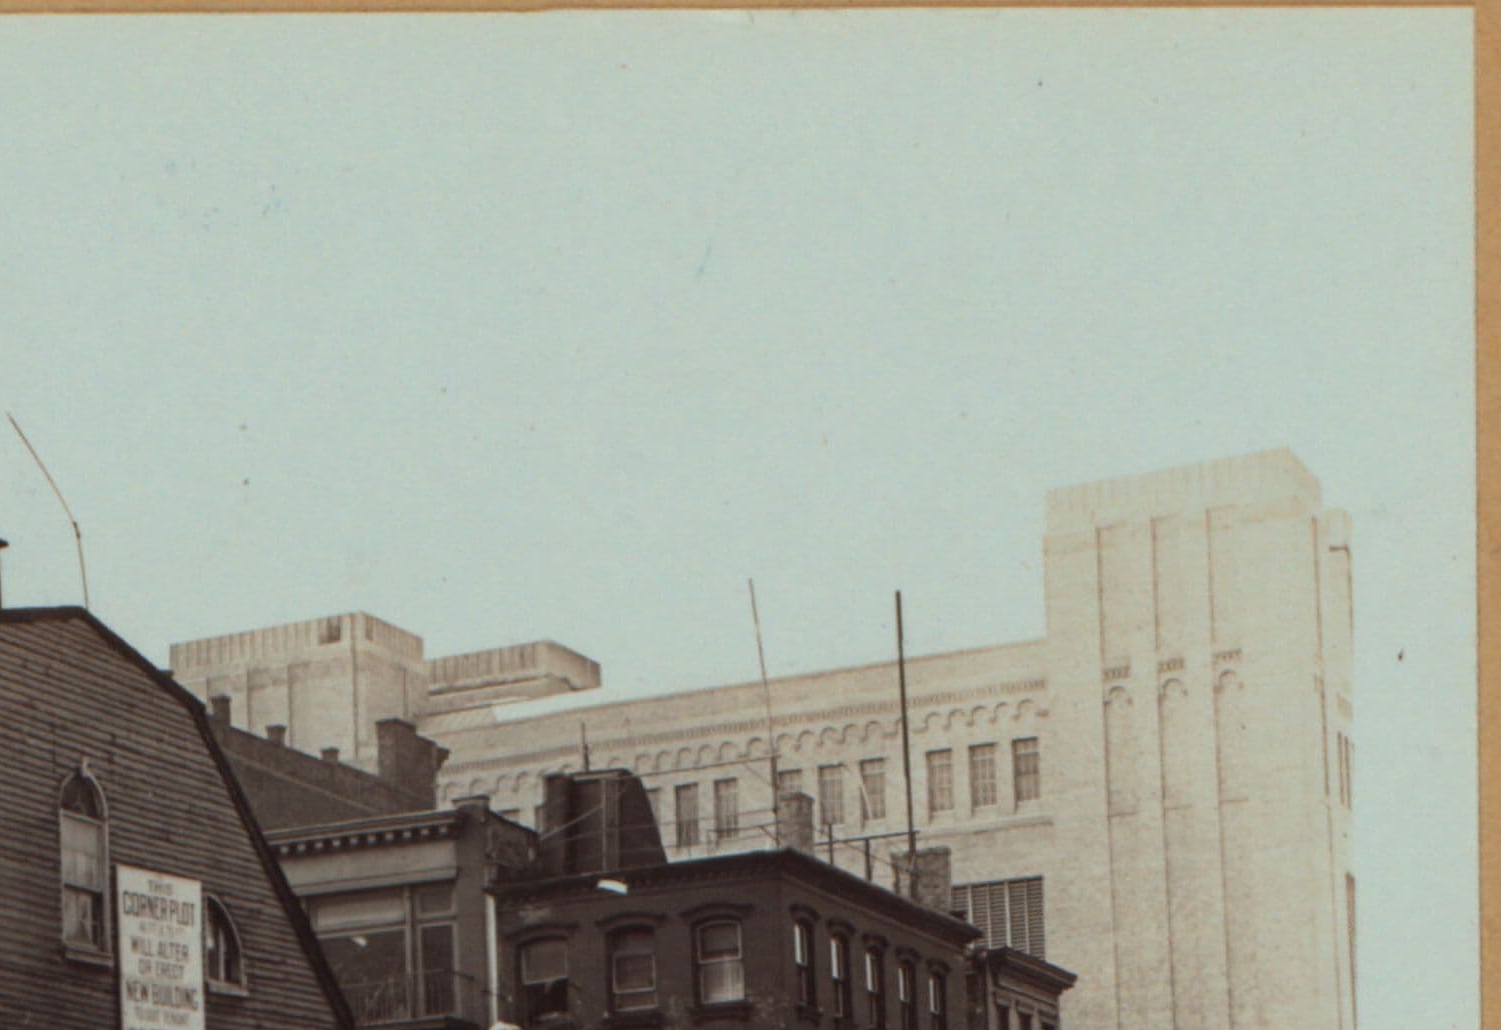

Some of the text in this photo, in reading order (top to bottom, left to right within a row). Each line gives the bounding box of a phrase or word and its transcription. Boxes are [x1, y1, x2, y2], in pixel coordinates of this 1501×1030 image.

[123, 891, 195, 927] CORNER PLOT
[131, 936, 189, 963] WILL ALTER
[155, 960, 185, 979] ERECT
[126, 979, 198, 1011] NEW BUILDING
